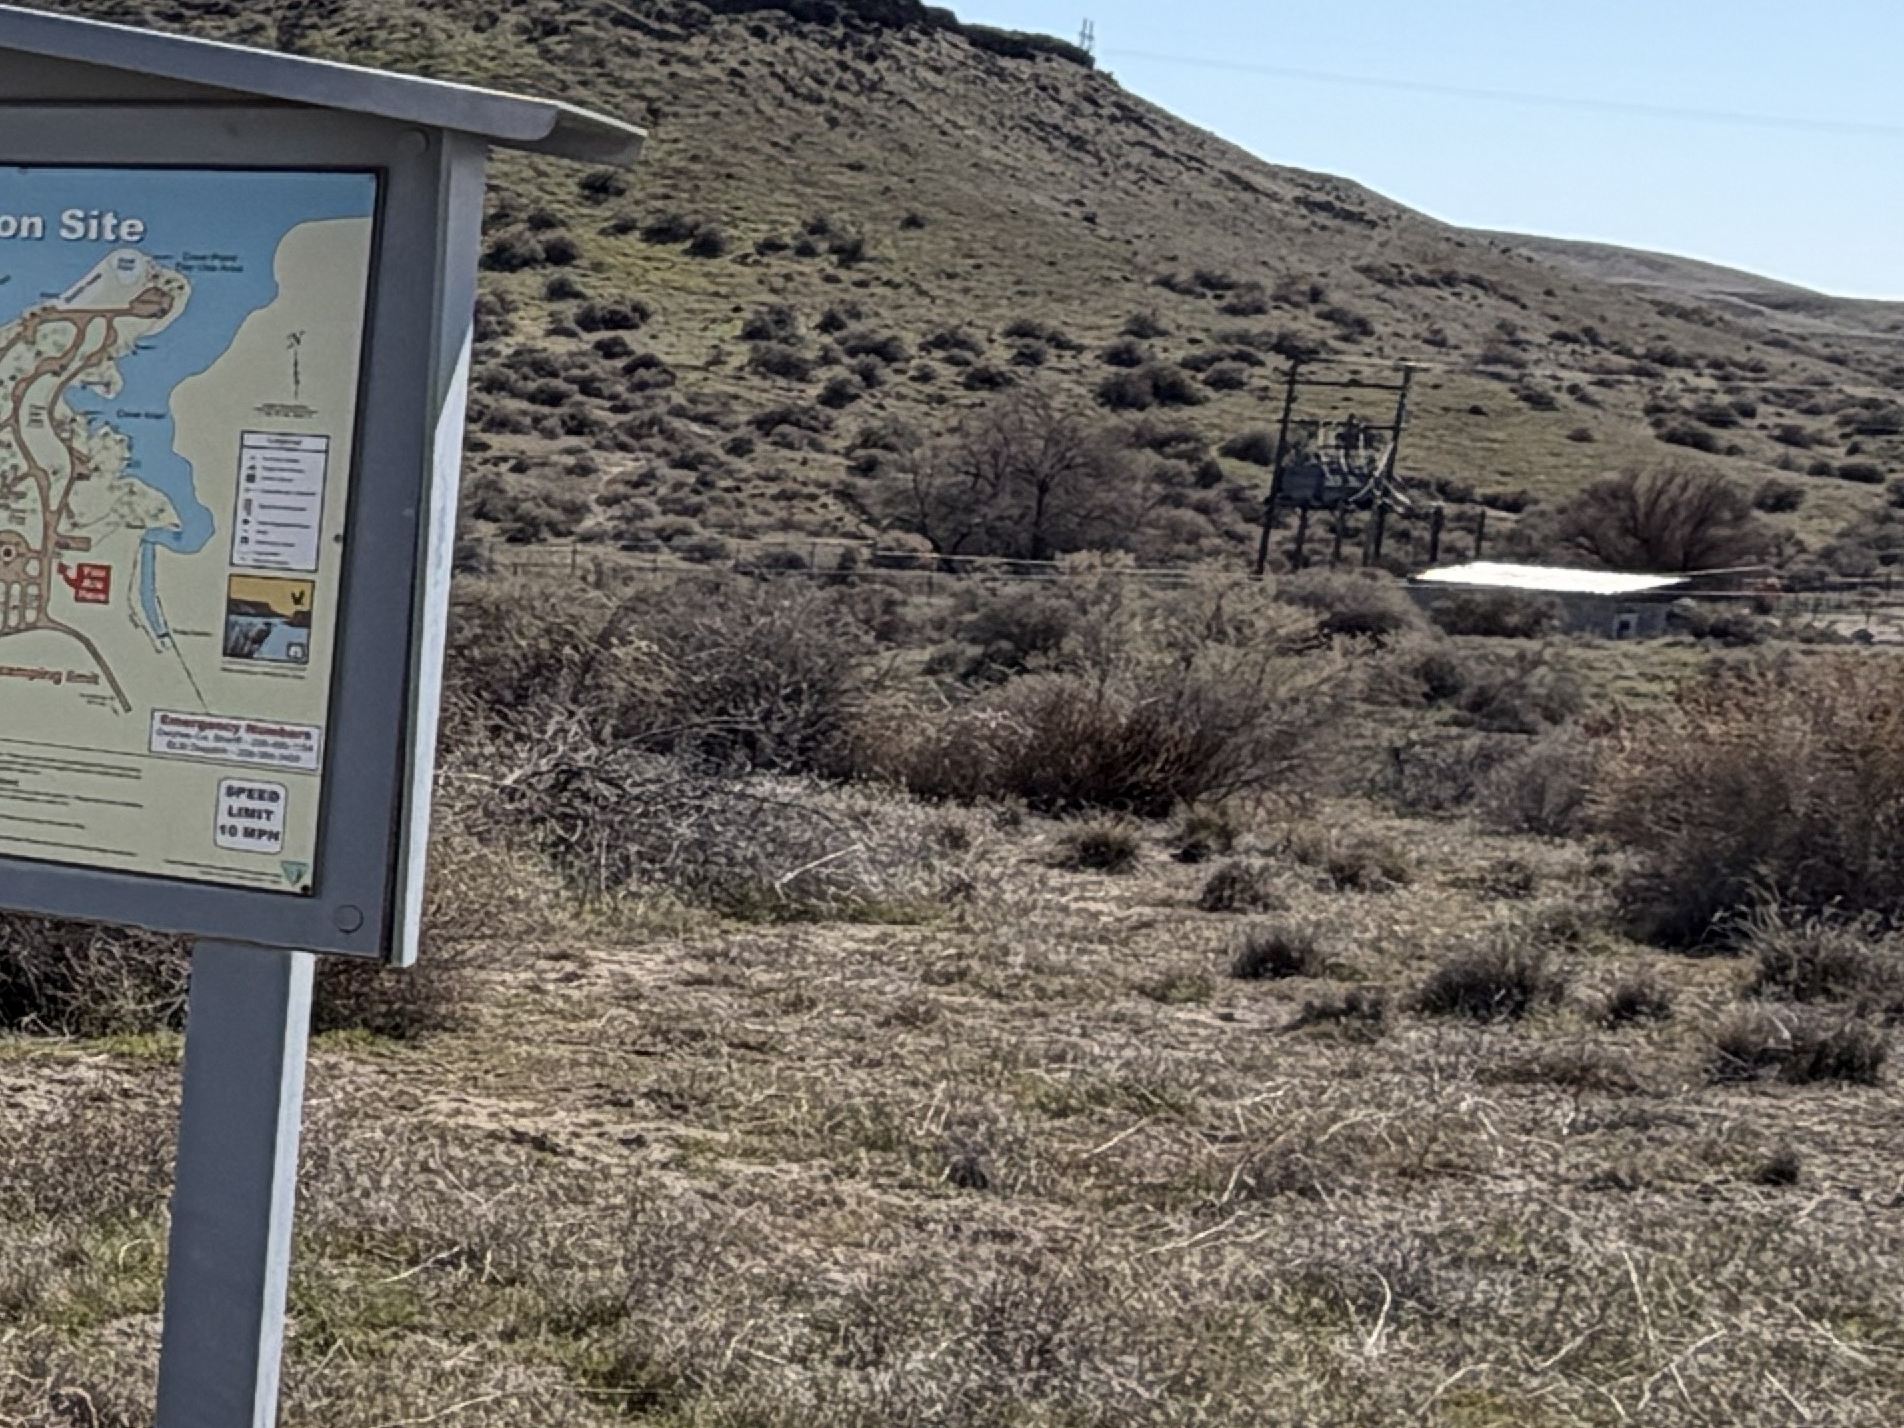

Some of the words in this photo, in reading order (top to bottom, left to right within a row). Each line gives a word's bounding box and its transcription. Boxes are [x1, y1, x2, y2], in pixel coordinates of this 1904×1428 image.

[57, 207, 148, 245] Site
[226, 784, 280, 803] SPEED
[228, 804, 275, 821] LIMIT
[219, 824, 238, 838] 10
[242, 826, 280, 842] MPH
